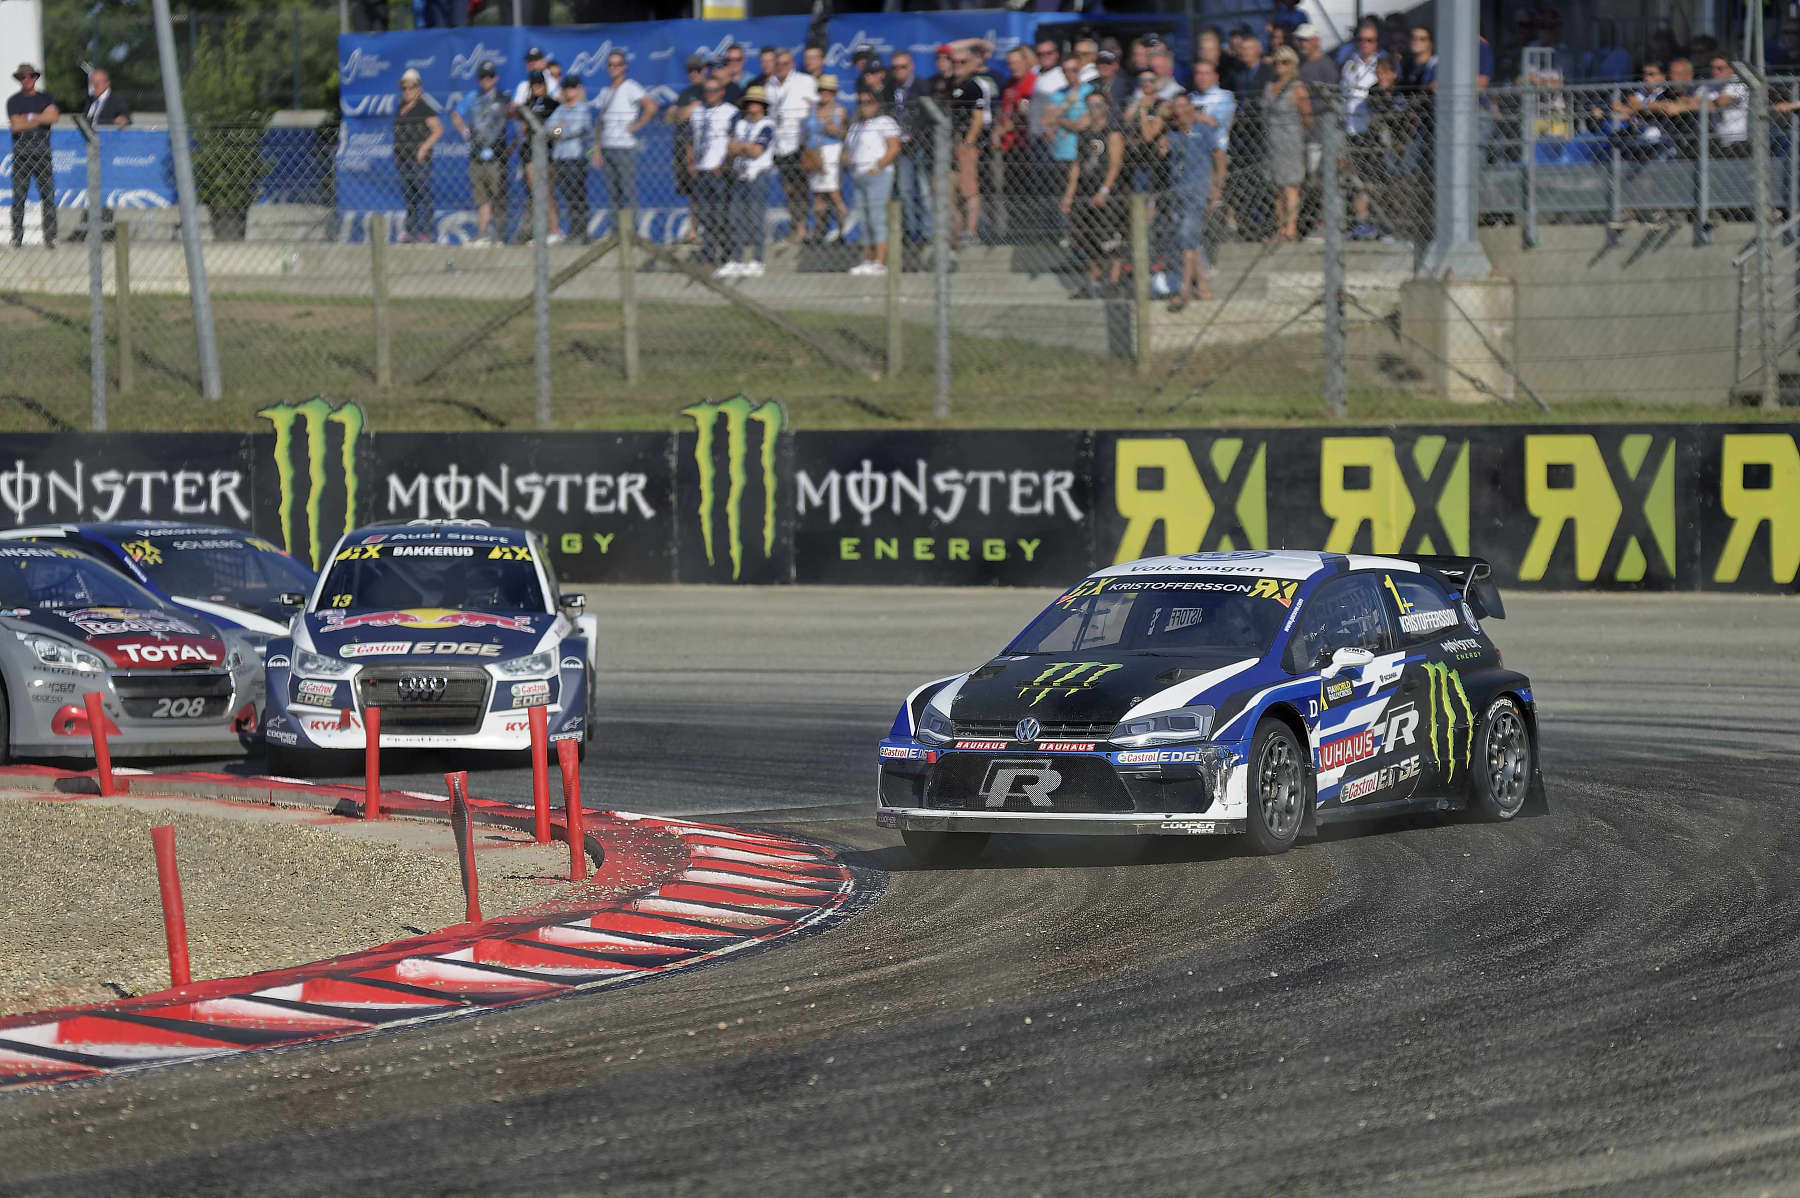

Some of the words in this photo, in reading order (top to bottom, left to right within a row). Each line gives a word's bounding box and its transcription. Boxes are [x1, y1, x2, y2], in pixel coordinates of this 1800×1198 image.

[387, 463, 655, 521] MONSTER
[795, 459, 1084, 526] MONSTER
[390, 532, 441, 542] Audi
[447, 532, 509, 544] Sport
[392, 546, 475, 557] BAKKERUD
[841, 537, 1041, 561] ENERGY
[1131, 564, 1265, 574] Volkswagen
[1108, 581, 1251, 594] KRISTOFFERSSON
[331, 594, 353, 608] 13
[1398, 608, 1459, 633] KRISTOFFERSSON
[356, 642, 406, 655] Castrol
[411, 641, 504, 657] EDGE
[1440, 637, 1482, 653] MONSTER
[117, 644, 217, 662] TOTAL
[297, 692, 334, 707] EDGE
[512, 693, 551, 709] EDGE
[152, 698, 205, 718] 208
[1488, 698, 1513, 721] COOPER
[884, 748, 907, 758] Castrol
[955, 741, 1008, 750] BAUHAUS
[1039, 743, 1096, 752] BAUHAUS
[1127, 752, 1156, 763] Castrol
[1348, 775, 1377, 800] Castrol
[1160, 821, 1216, 829] COOPER
